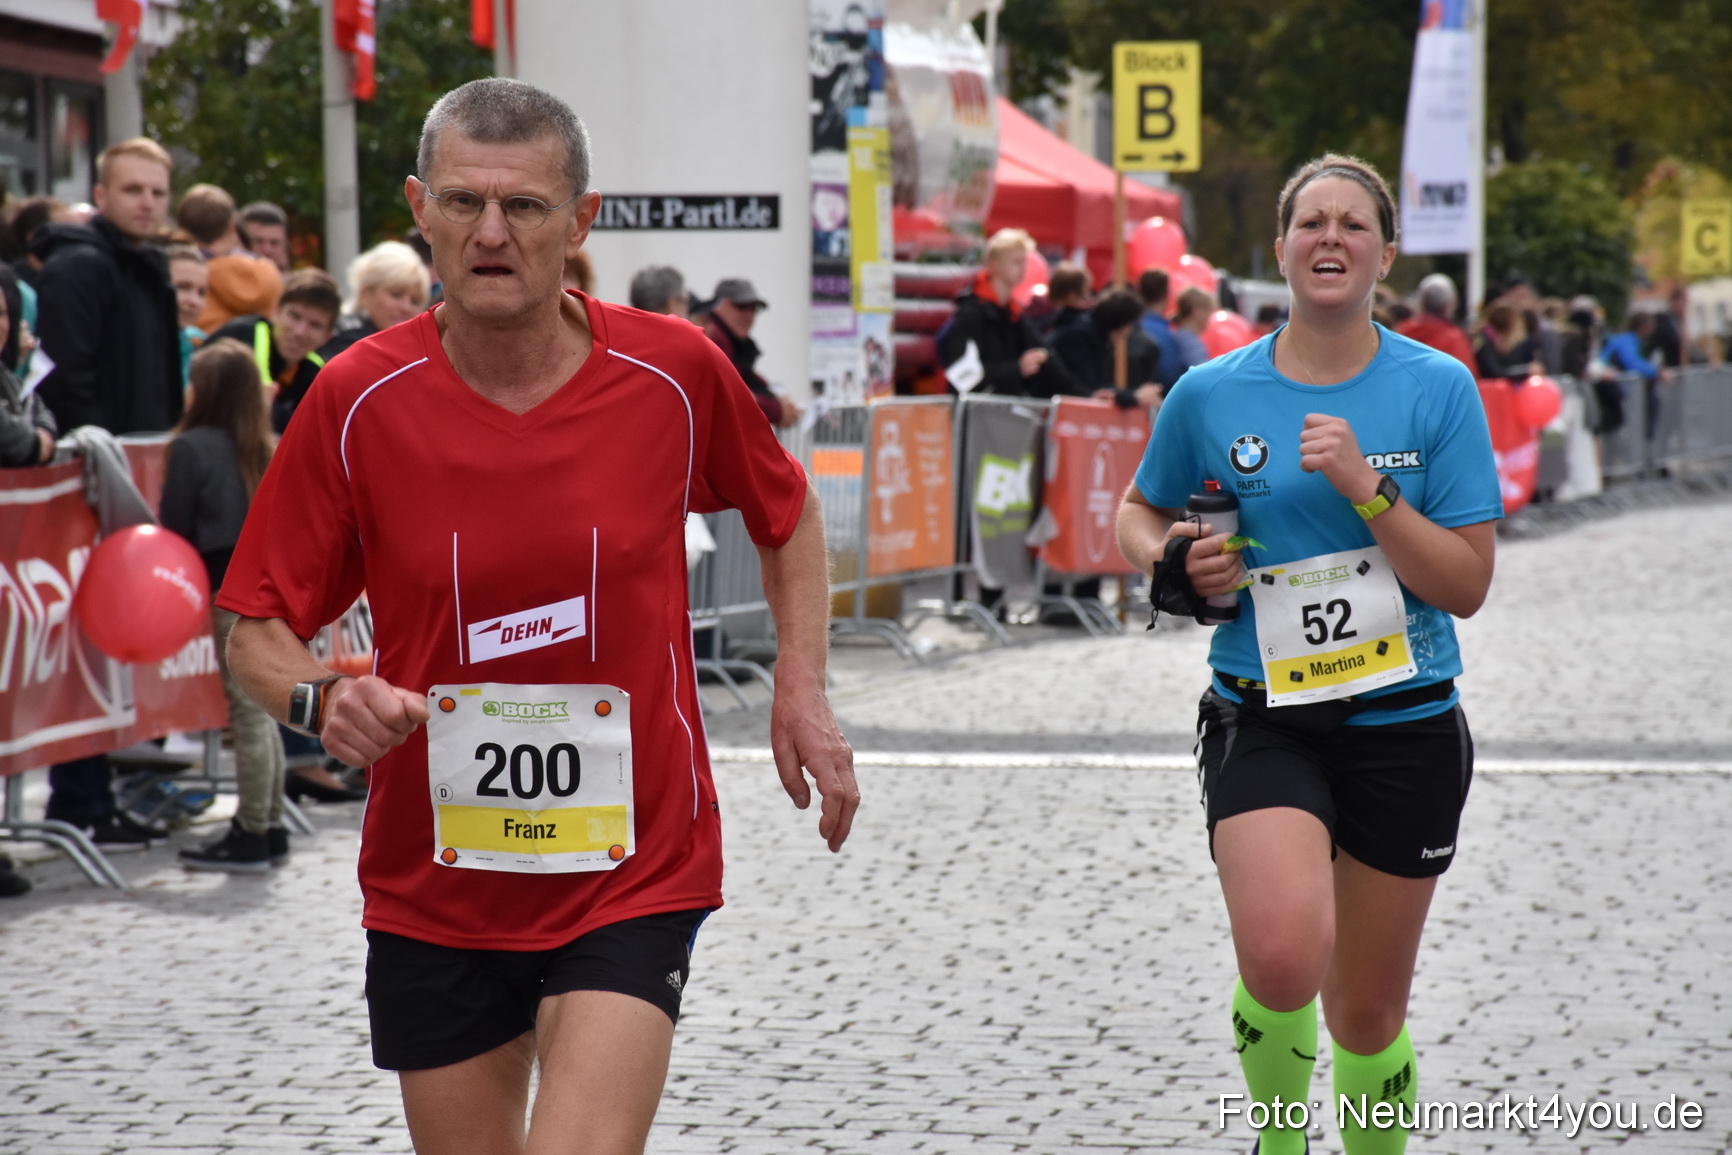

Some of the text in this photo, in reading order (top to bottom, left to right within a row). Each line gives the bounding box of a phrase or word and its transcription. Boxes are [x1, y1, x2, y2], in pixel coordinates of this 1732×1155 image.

[1124, 50, 1187, 73] Block
[1138, 84, 1175, 140] B
[594, 196, 771, 229] INI-Partl.de
[1694, 221, 1720, 257] C
[1365, 452, 1421, 470] OCK
[1236, 479, 1271, 491] PARTL
[1238, 491, 1272, 499] Neumarkt
[1301, 565, 1350, 585] BOCK
[500, 616, 553, 645] DEHN
[1301, 598, 1358, 646] 52
[1267, 647, 1274, 656] C
[1309, 654, 1366, 678] Martina
[502, 702, 569, 719] BOCK
[474, 742, 581, 800] 200
[440, 788, 448, 798] D
[504, 818, 557, 840] Franz
